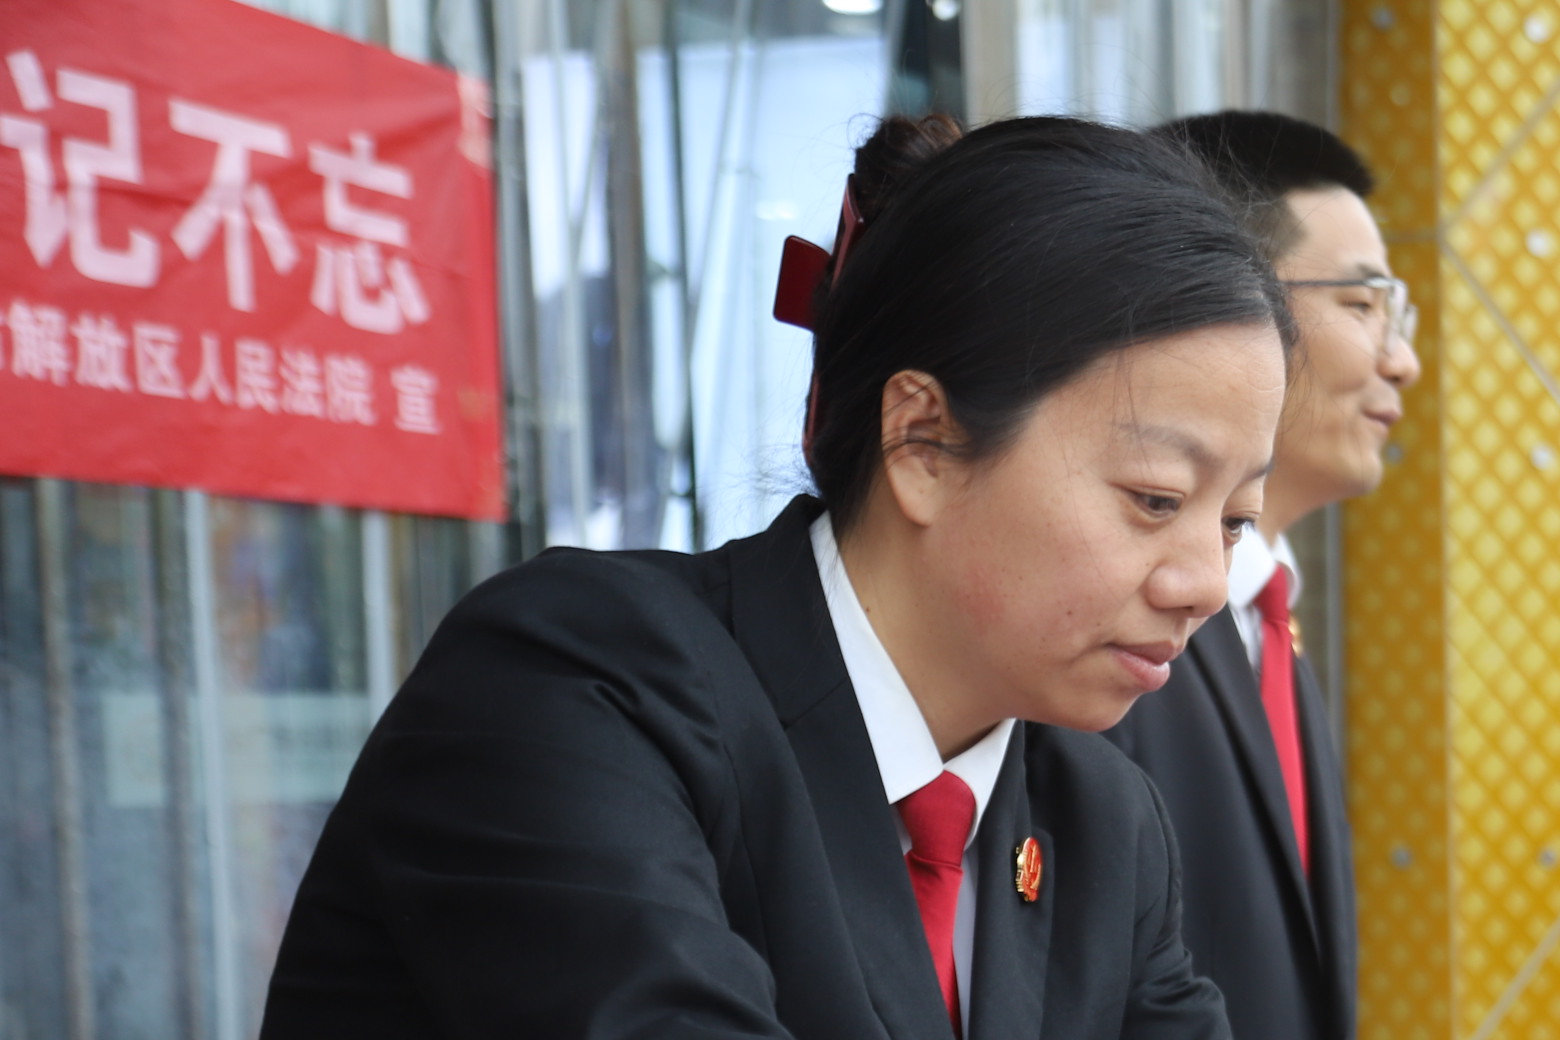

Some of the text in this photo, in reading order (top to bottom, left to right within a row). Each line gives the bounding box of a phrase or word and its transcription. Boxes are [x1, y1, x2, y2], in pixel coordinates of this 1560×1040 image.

[0, 50, 431, 335] 记不忘
[0, 298, 441, 435] 解放区人民法院 宣
